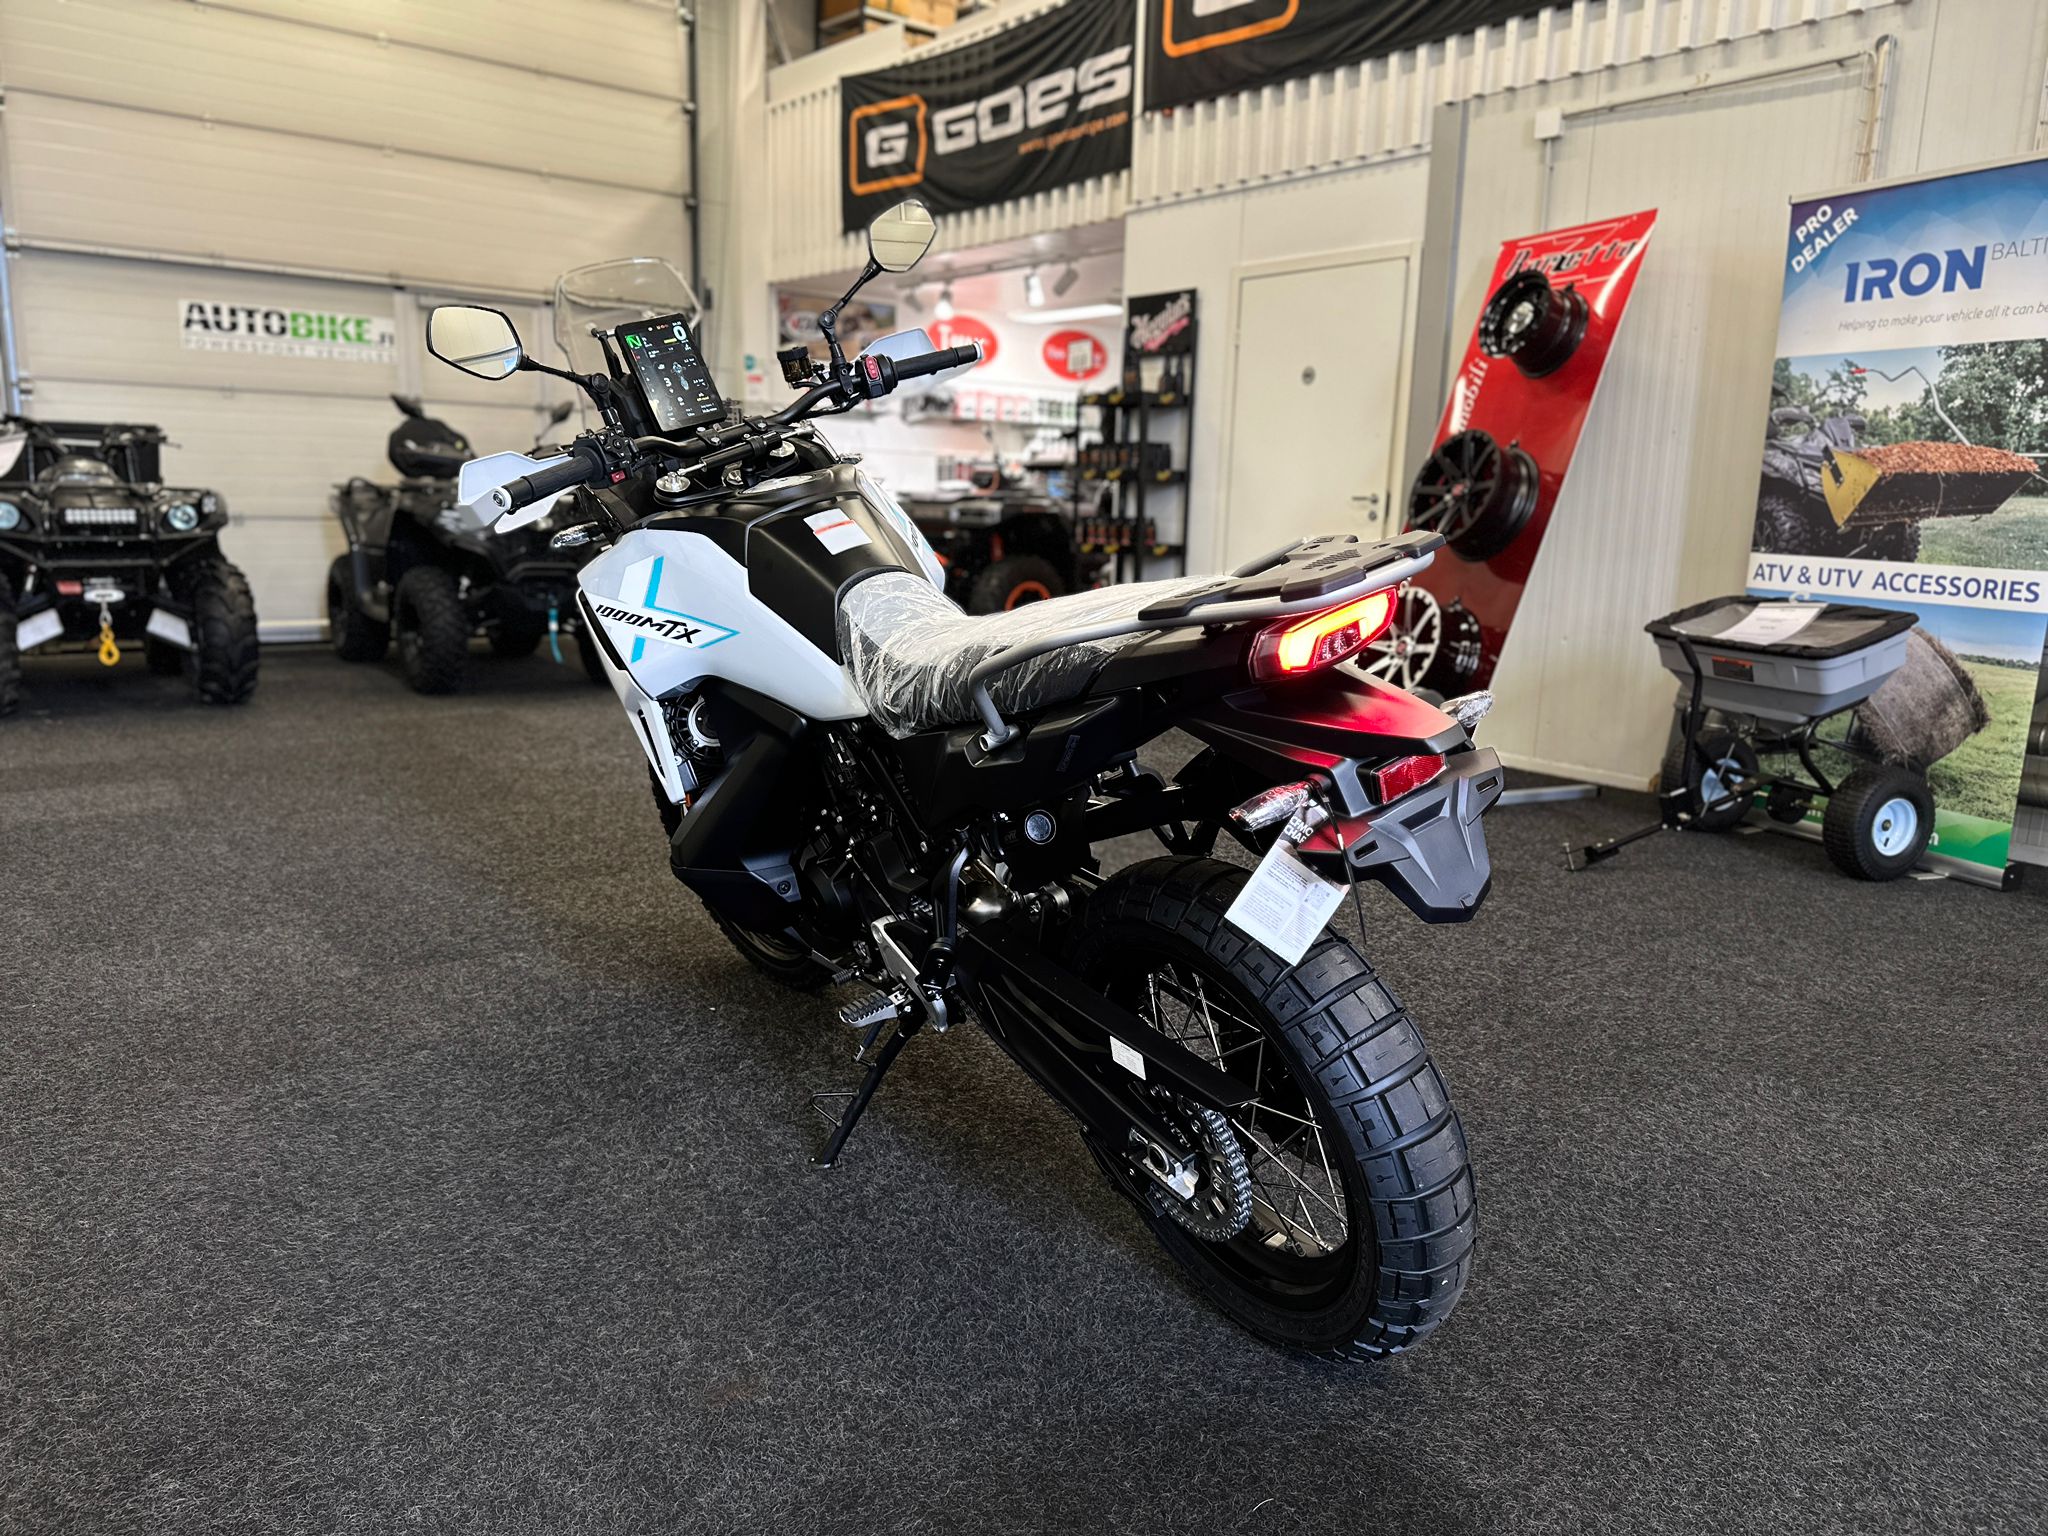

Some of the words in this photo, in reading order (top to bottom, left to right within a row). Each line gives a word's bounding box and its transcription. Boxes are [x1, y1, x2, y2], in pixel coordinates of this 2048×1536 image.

[1791, 207, 1859, 273] DEALER
[1795, 204, 1833, 243] PRO
[1844, 245, 1987, 303] IRON
[1838, 319, 1876, 332] Helping
[1877, 318, 1889, 328] to
[1891, 314, 1918, 326] make
[1918, 313, 1944, 326] your
[1946, 306, 1983, 322] vehicle
[1985, 305, 2000, 319] all
[2001, 305, 2010, 317] it
[2012, 305, 2033, 315] can
[1753, 562, 1793, 583] ATV
[1797, 566, 1811, 584] &
[1818, 568, 1863, 588] UTV
[1872, 571, 2040, 603] ACCESSORIES
